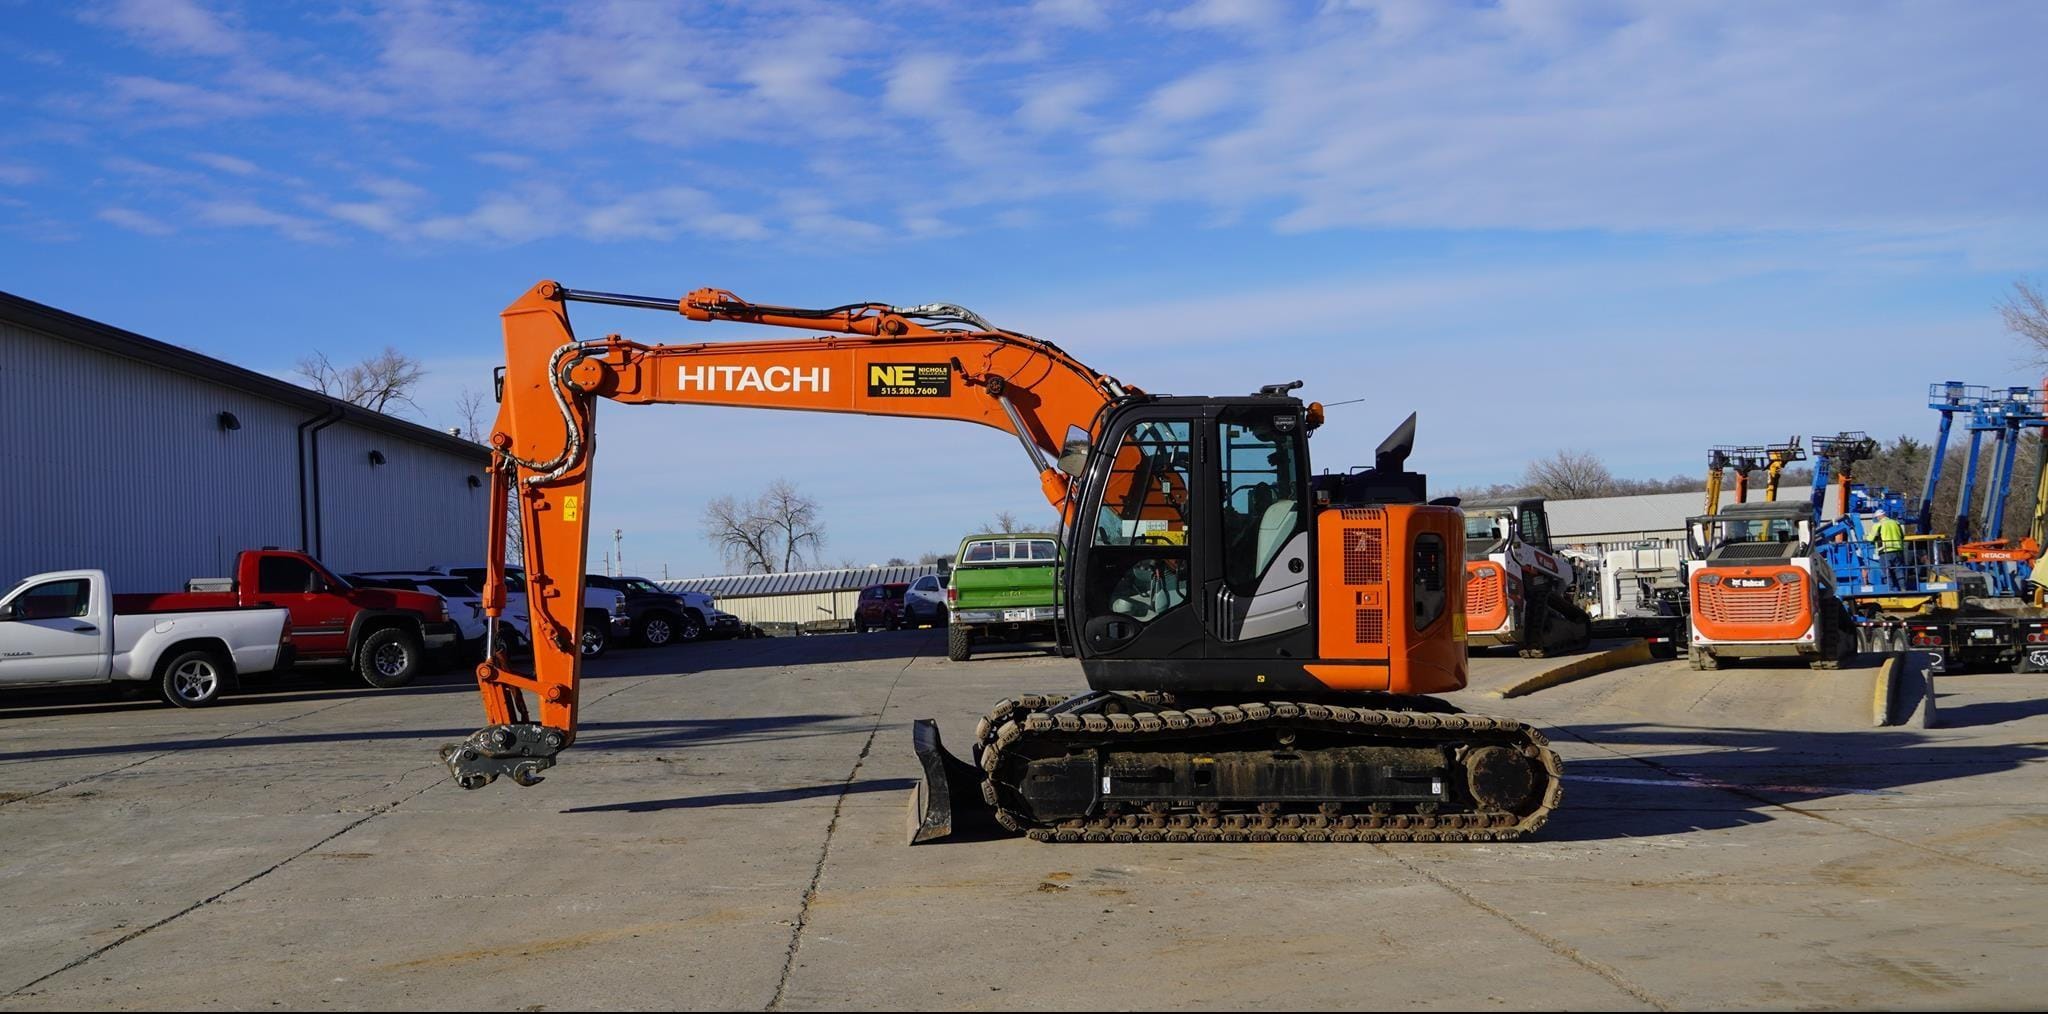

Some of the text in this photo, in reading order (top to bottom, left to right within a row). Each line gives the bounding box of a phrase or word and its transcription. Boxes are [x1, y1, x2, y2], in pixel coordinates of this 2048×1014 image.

[678, 366, 830, 392] HITACHI
[871, 366, 916, 386] NE
[881, 387, 938, 395] 515.280.7600
[1742, 579, 1765, 587] Bobcat
